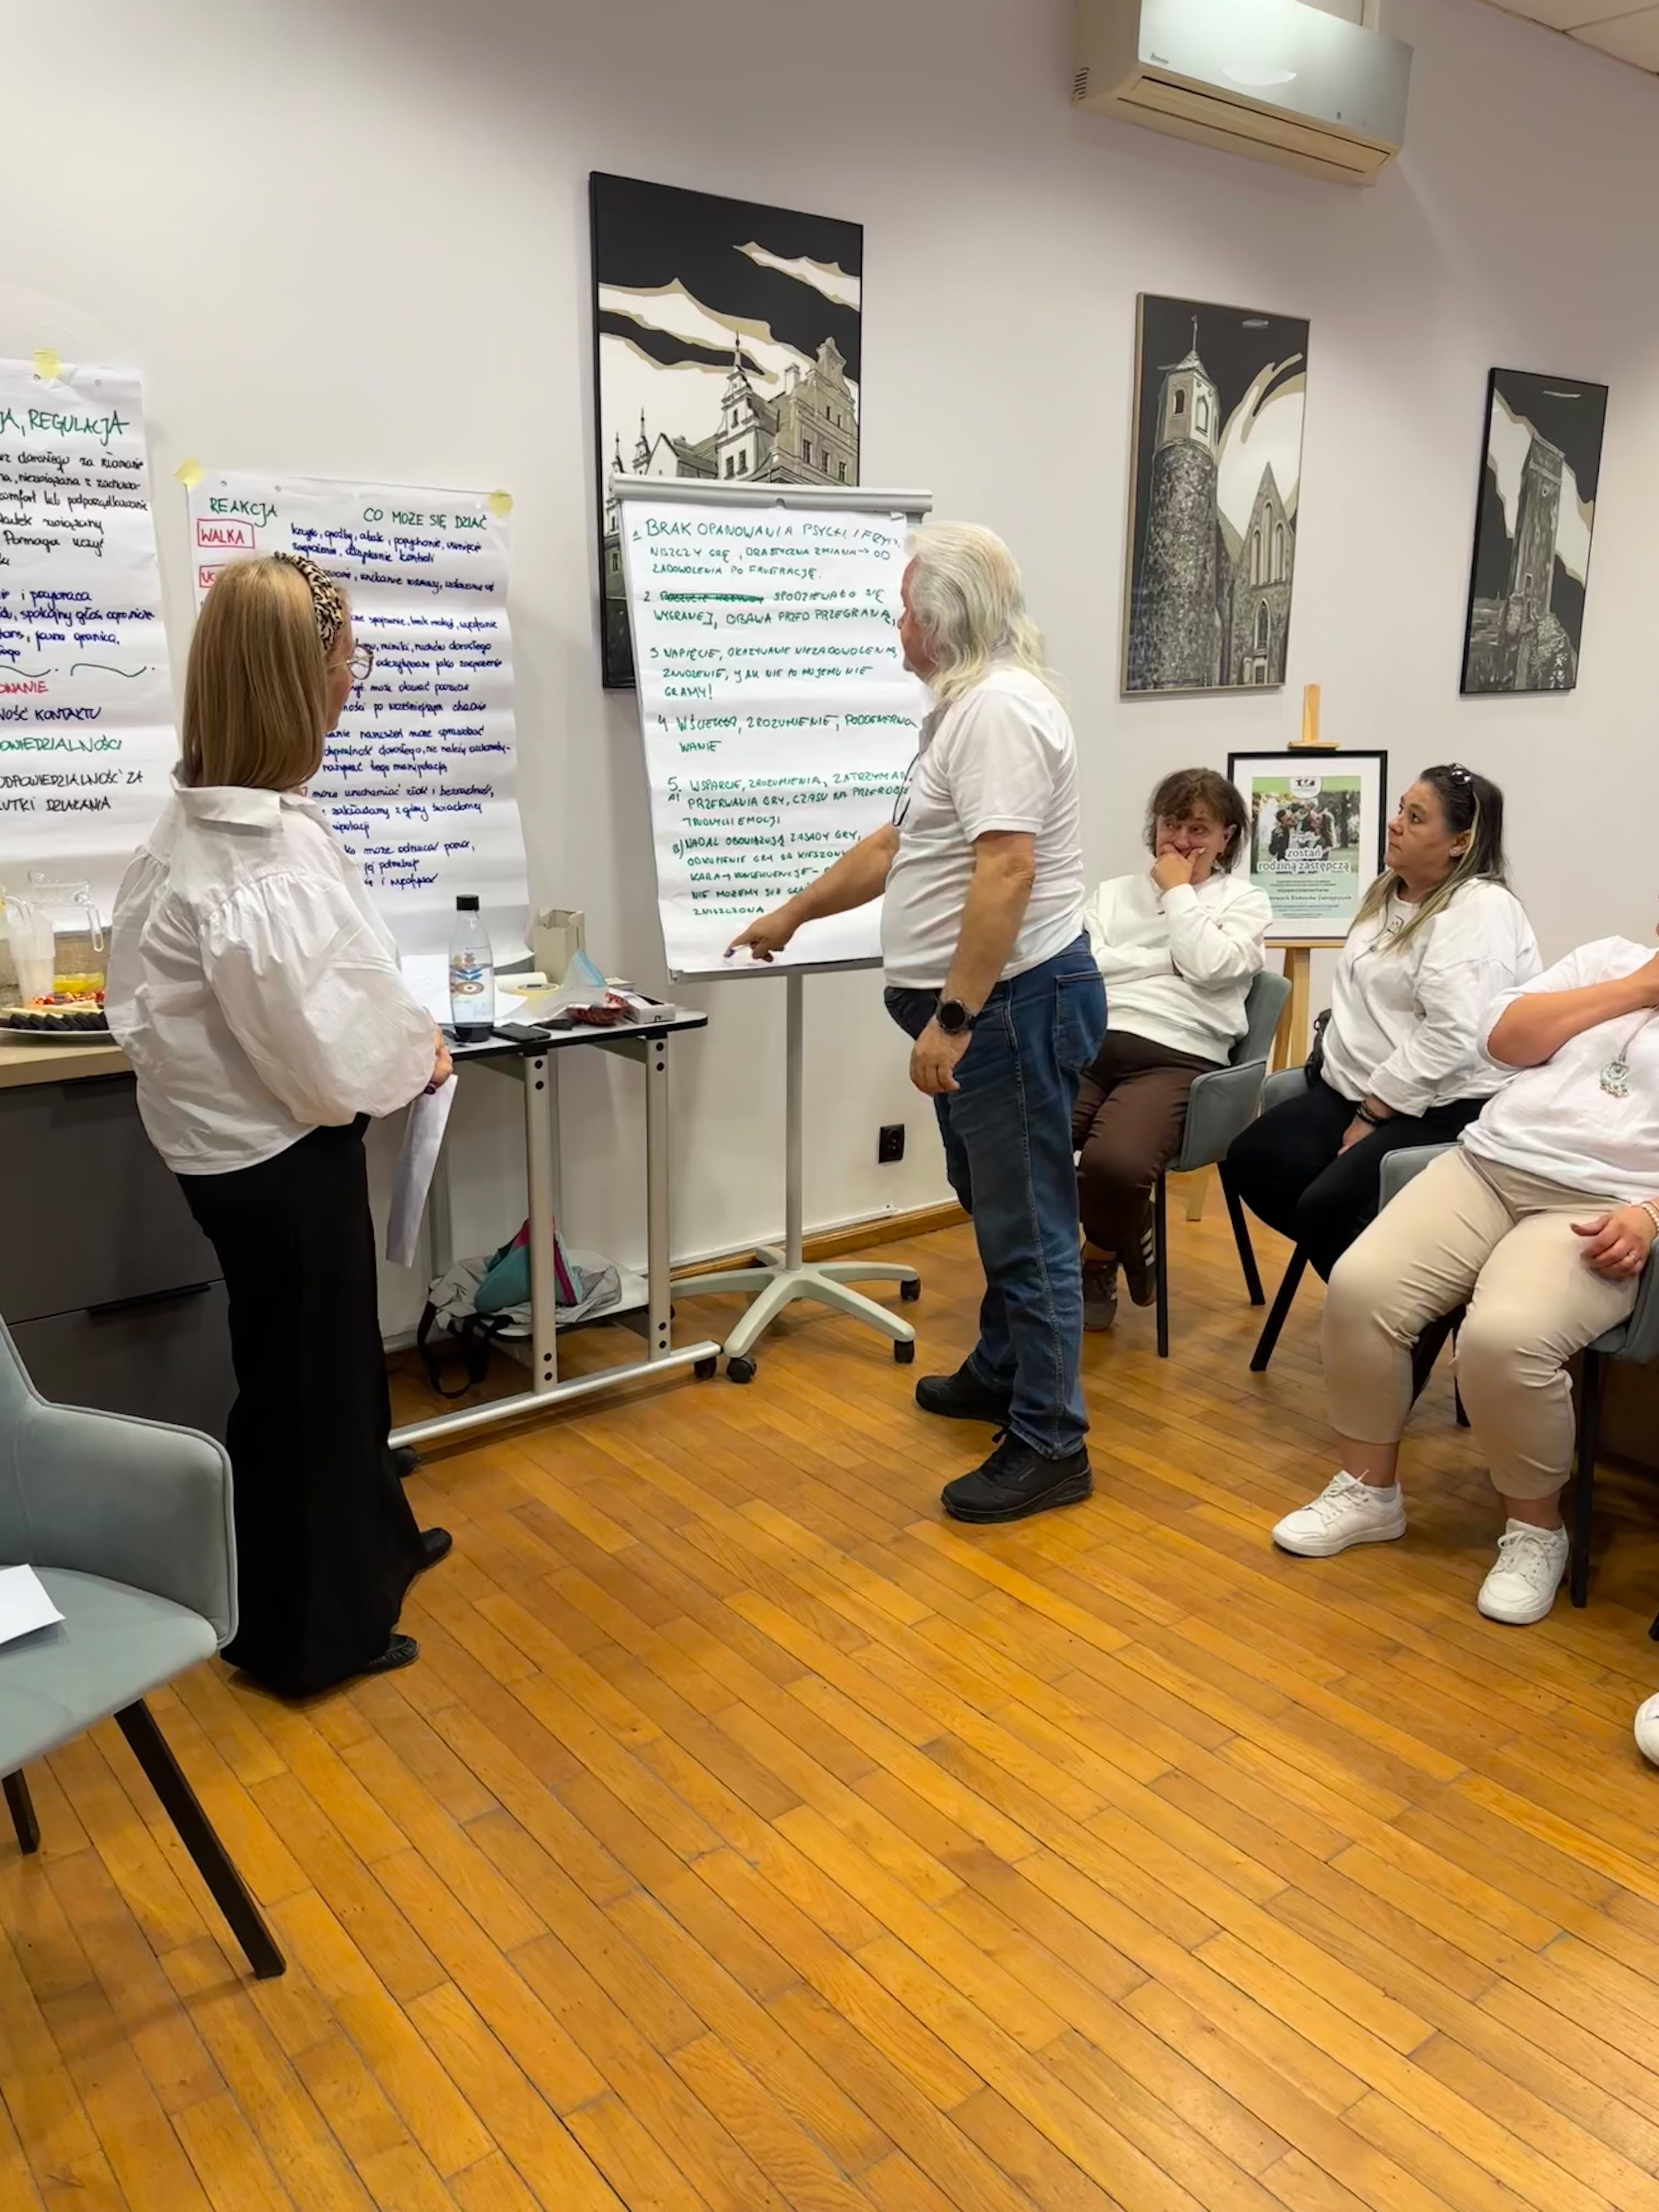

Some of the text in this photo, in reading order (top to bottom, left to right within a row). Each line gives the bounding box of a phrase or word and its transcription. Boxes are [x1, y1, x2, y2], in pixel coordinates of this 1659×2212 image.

[28, 409, 129, 446] REGULACJA
[79, 456, 95, 466] za
[210, 498, 278, 528] REAKCJA
[363, 507, 383, 522] CO
[201, 528, 245, 544] WALKA
[646, 518, 692, 537] BRAK
[697, 522, 793, 539] OPANOWANIA
[3, 530, 60, 553] Pomaga
[653, 564, 723, 574] ZADOWOLENIA
[726, 613, 772, 624] OBAWA
[778, 611, 810, 623] PRZED
[35, 707, 101, 721] KONTAKTU
[679, 740, 722, 753] WANIE
[126, 770, 144, 785] ZA
